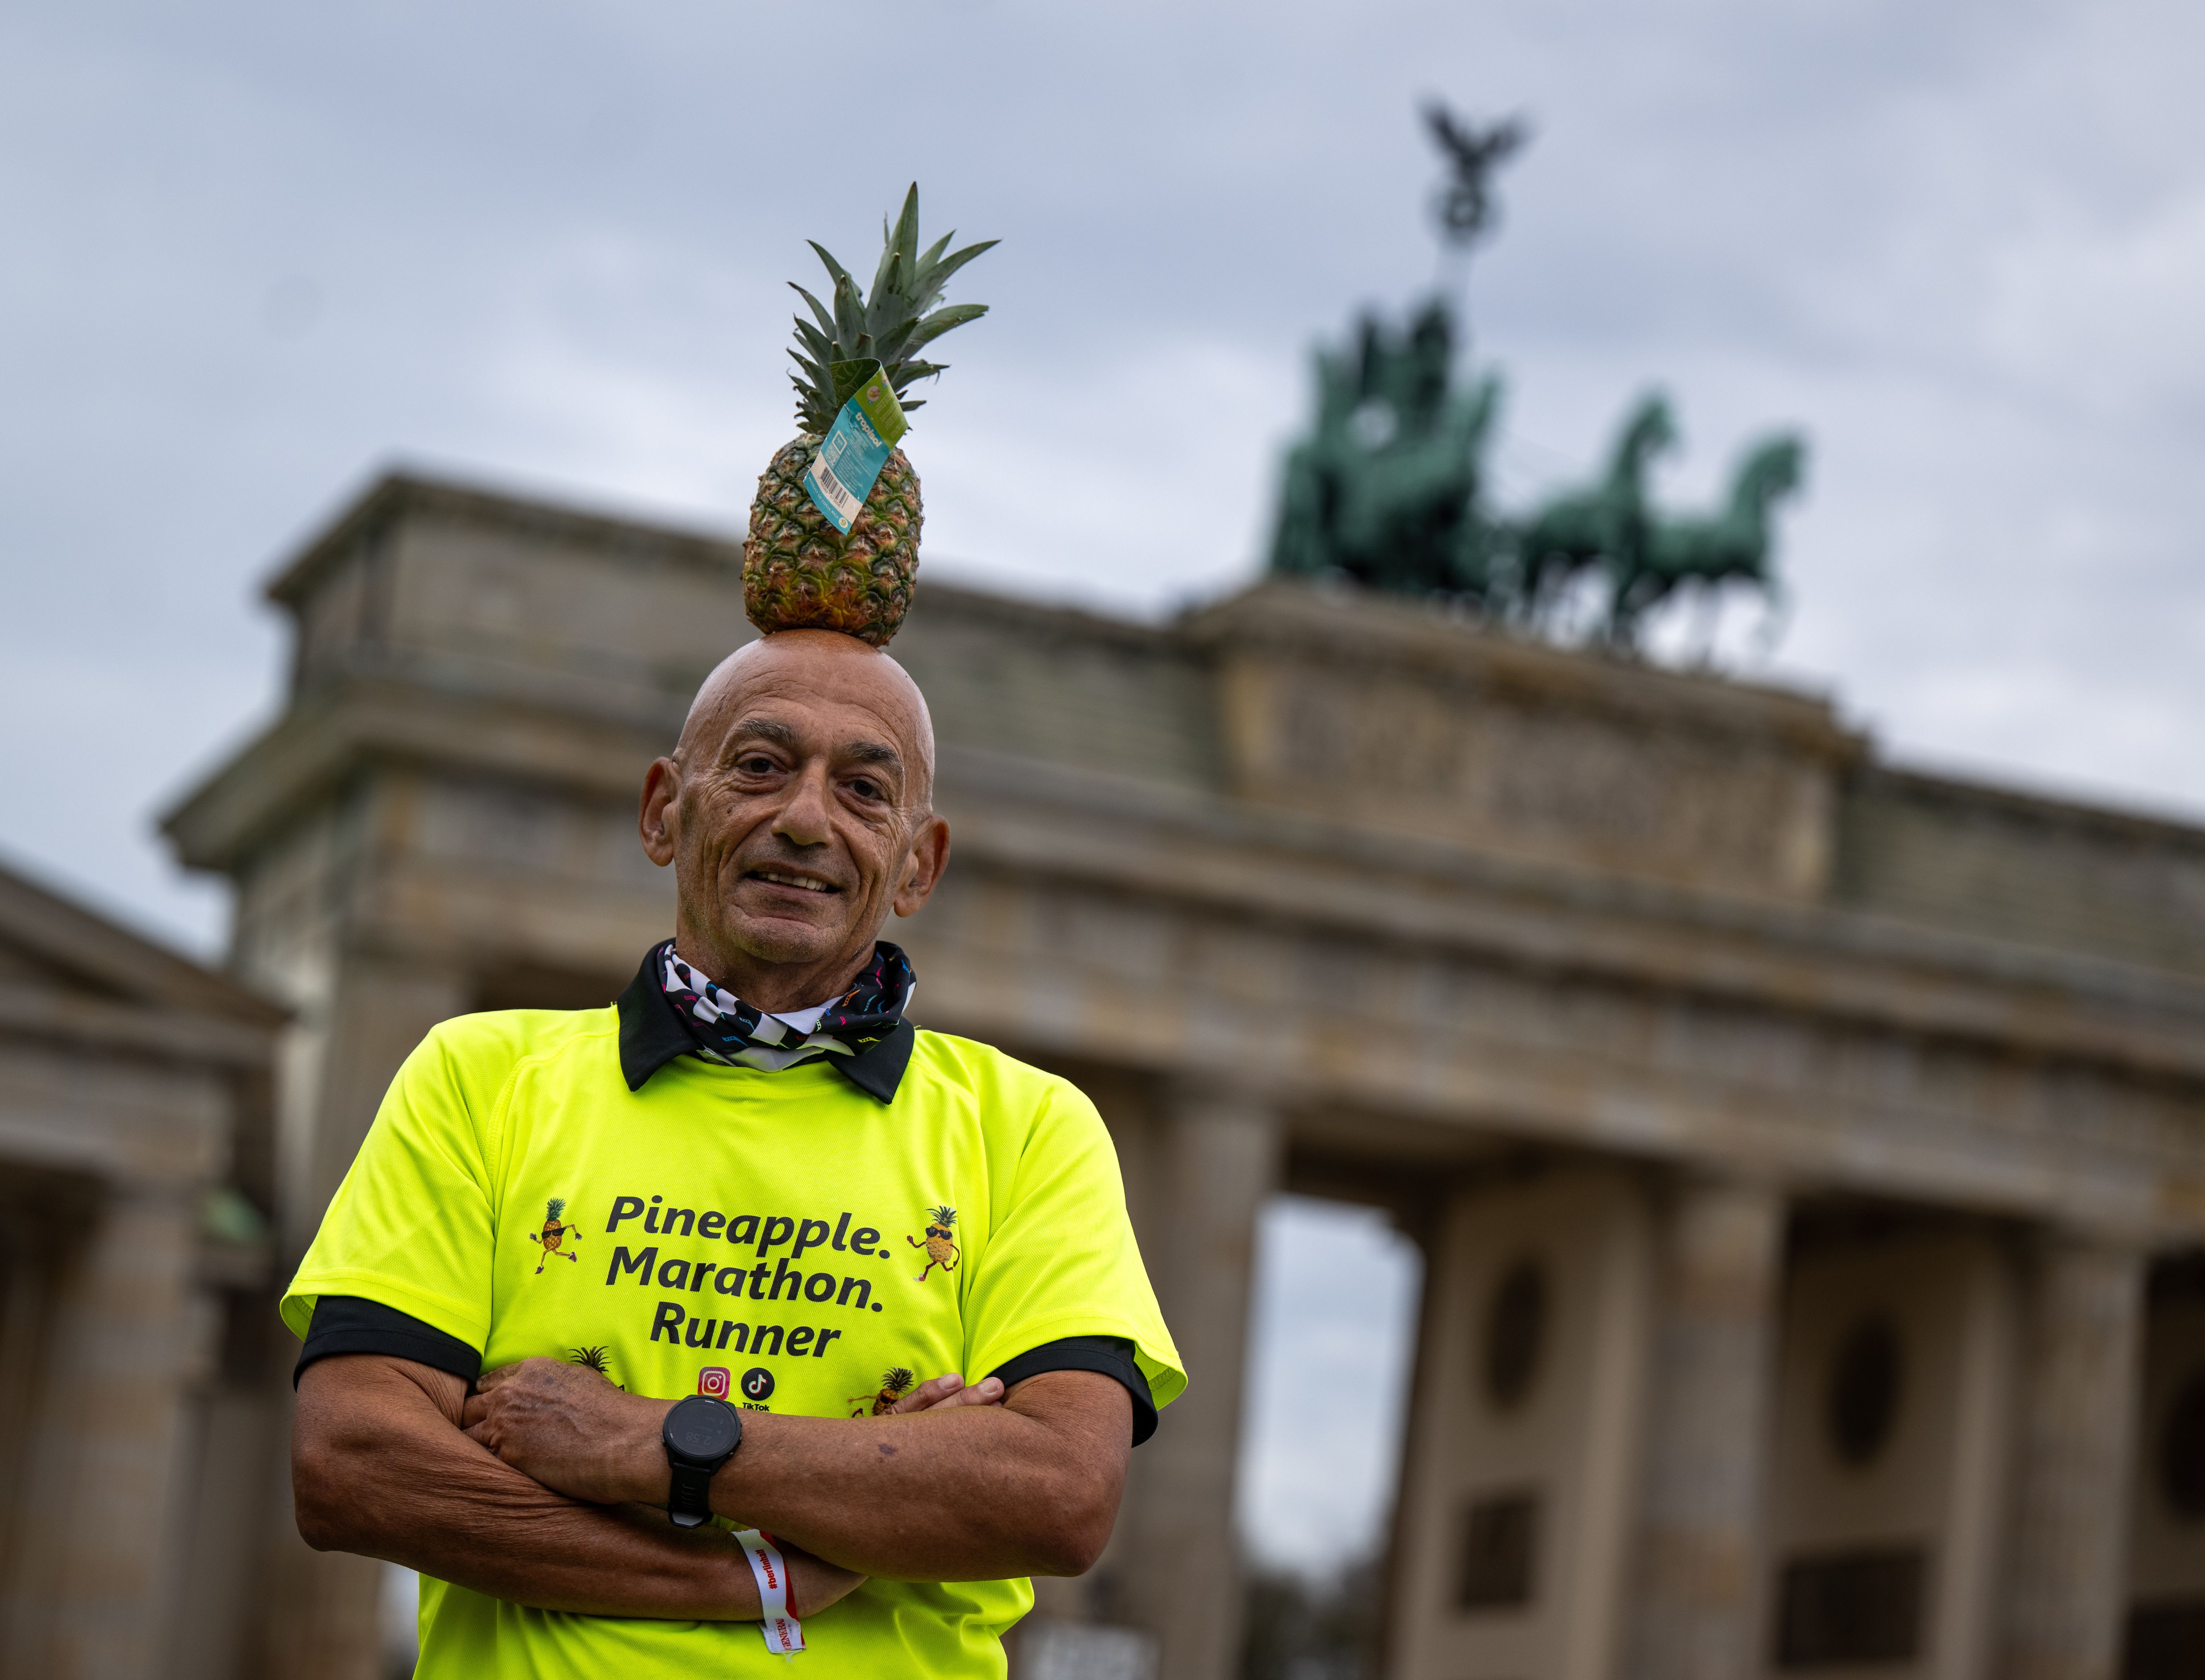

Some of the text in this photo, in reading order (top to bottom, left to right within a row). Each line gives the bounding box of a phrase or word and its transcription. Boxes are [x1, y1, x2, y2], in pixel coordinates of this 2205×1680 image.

[856, 412, 882, 447] tropisol
[821, 499, 831, 511] COSTA
[606, 1195, 890, 1259] Pineapple.
[606, 1246, 883, 1312] Marathon.
[650, 1301, 842, 1358] Runner
[742, 1402, 770, 1412] TikTok
[755, 1549, 778, 1589] #berlinhalf
